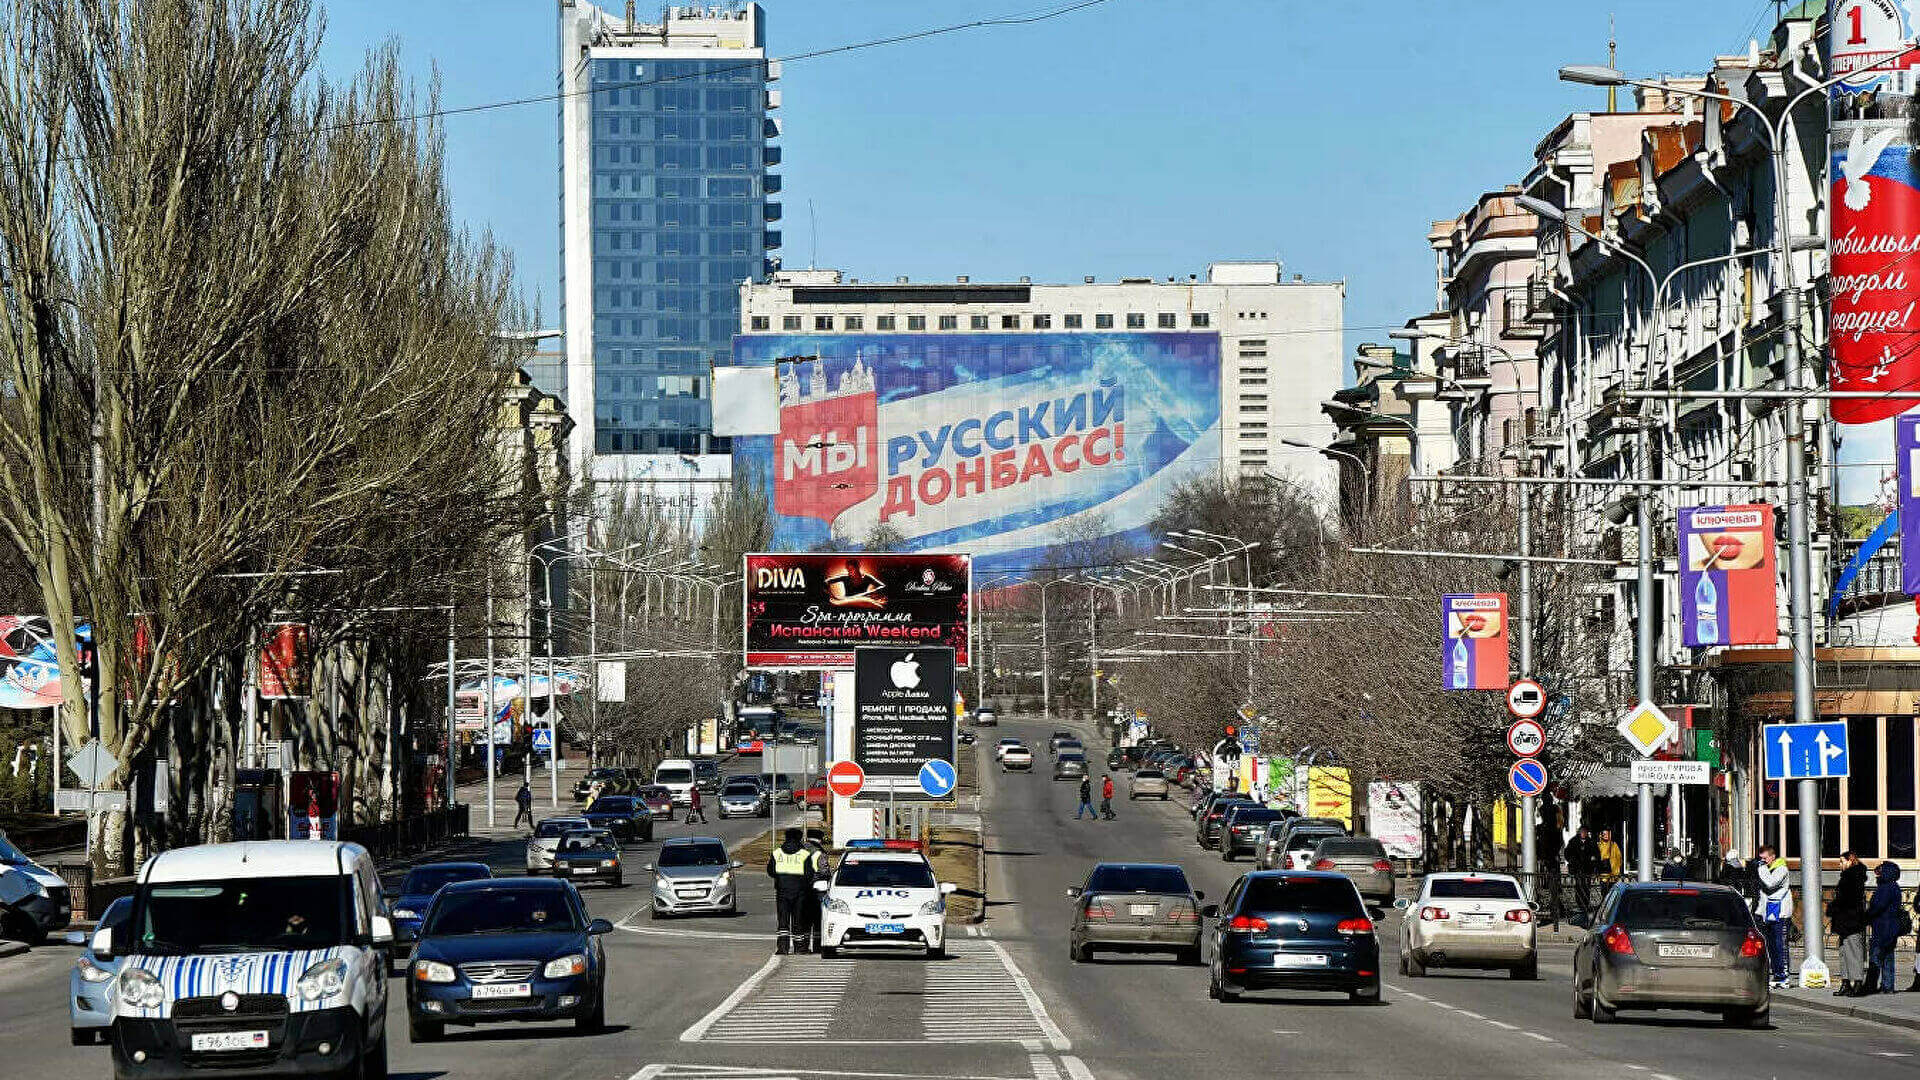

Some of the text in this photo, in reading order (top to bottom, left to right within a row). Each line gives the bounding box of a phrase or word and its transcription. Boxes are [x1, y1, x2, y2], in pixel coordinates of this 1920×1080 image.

[1846, 5, 1867, 45] 1
[1832, 300, 1916, 342] сердце!
[888, 378, 1125, 475] РУССКИЙ
[783, 423, 865, 482] МЫ
[880, 422, 1125, 523] ДОНБАСС!
[758, 567, 806, 589] DIVA
[770, 622, 941, 638] Испанский Weekend
[800, 605, 912, 629] Spa-программа
[861, 705, 948, 714] РЕМОНТ ПРОДАЖА
[855, 889, 910, 899] ДПС
